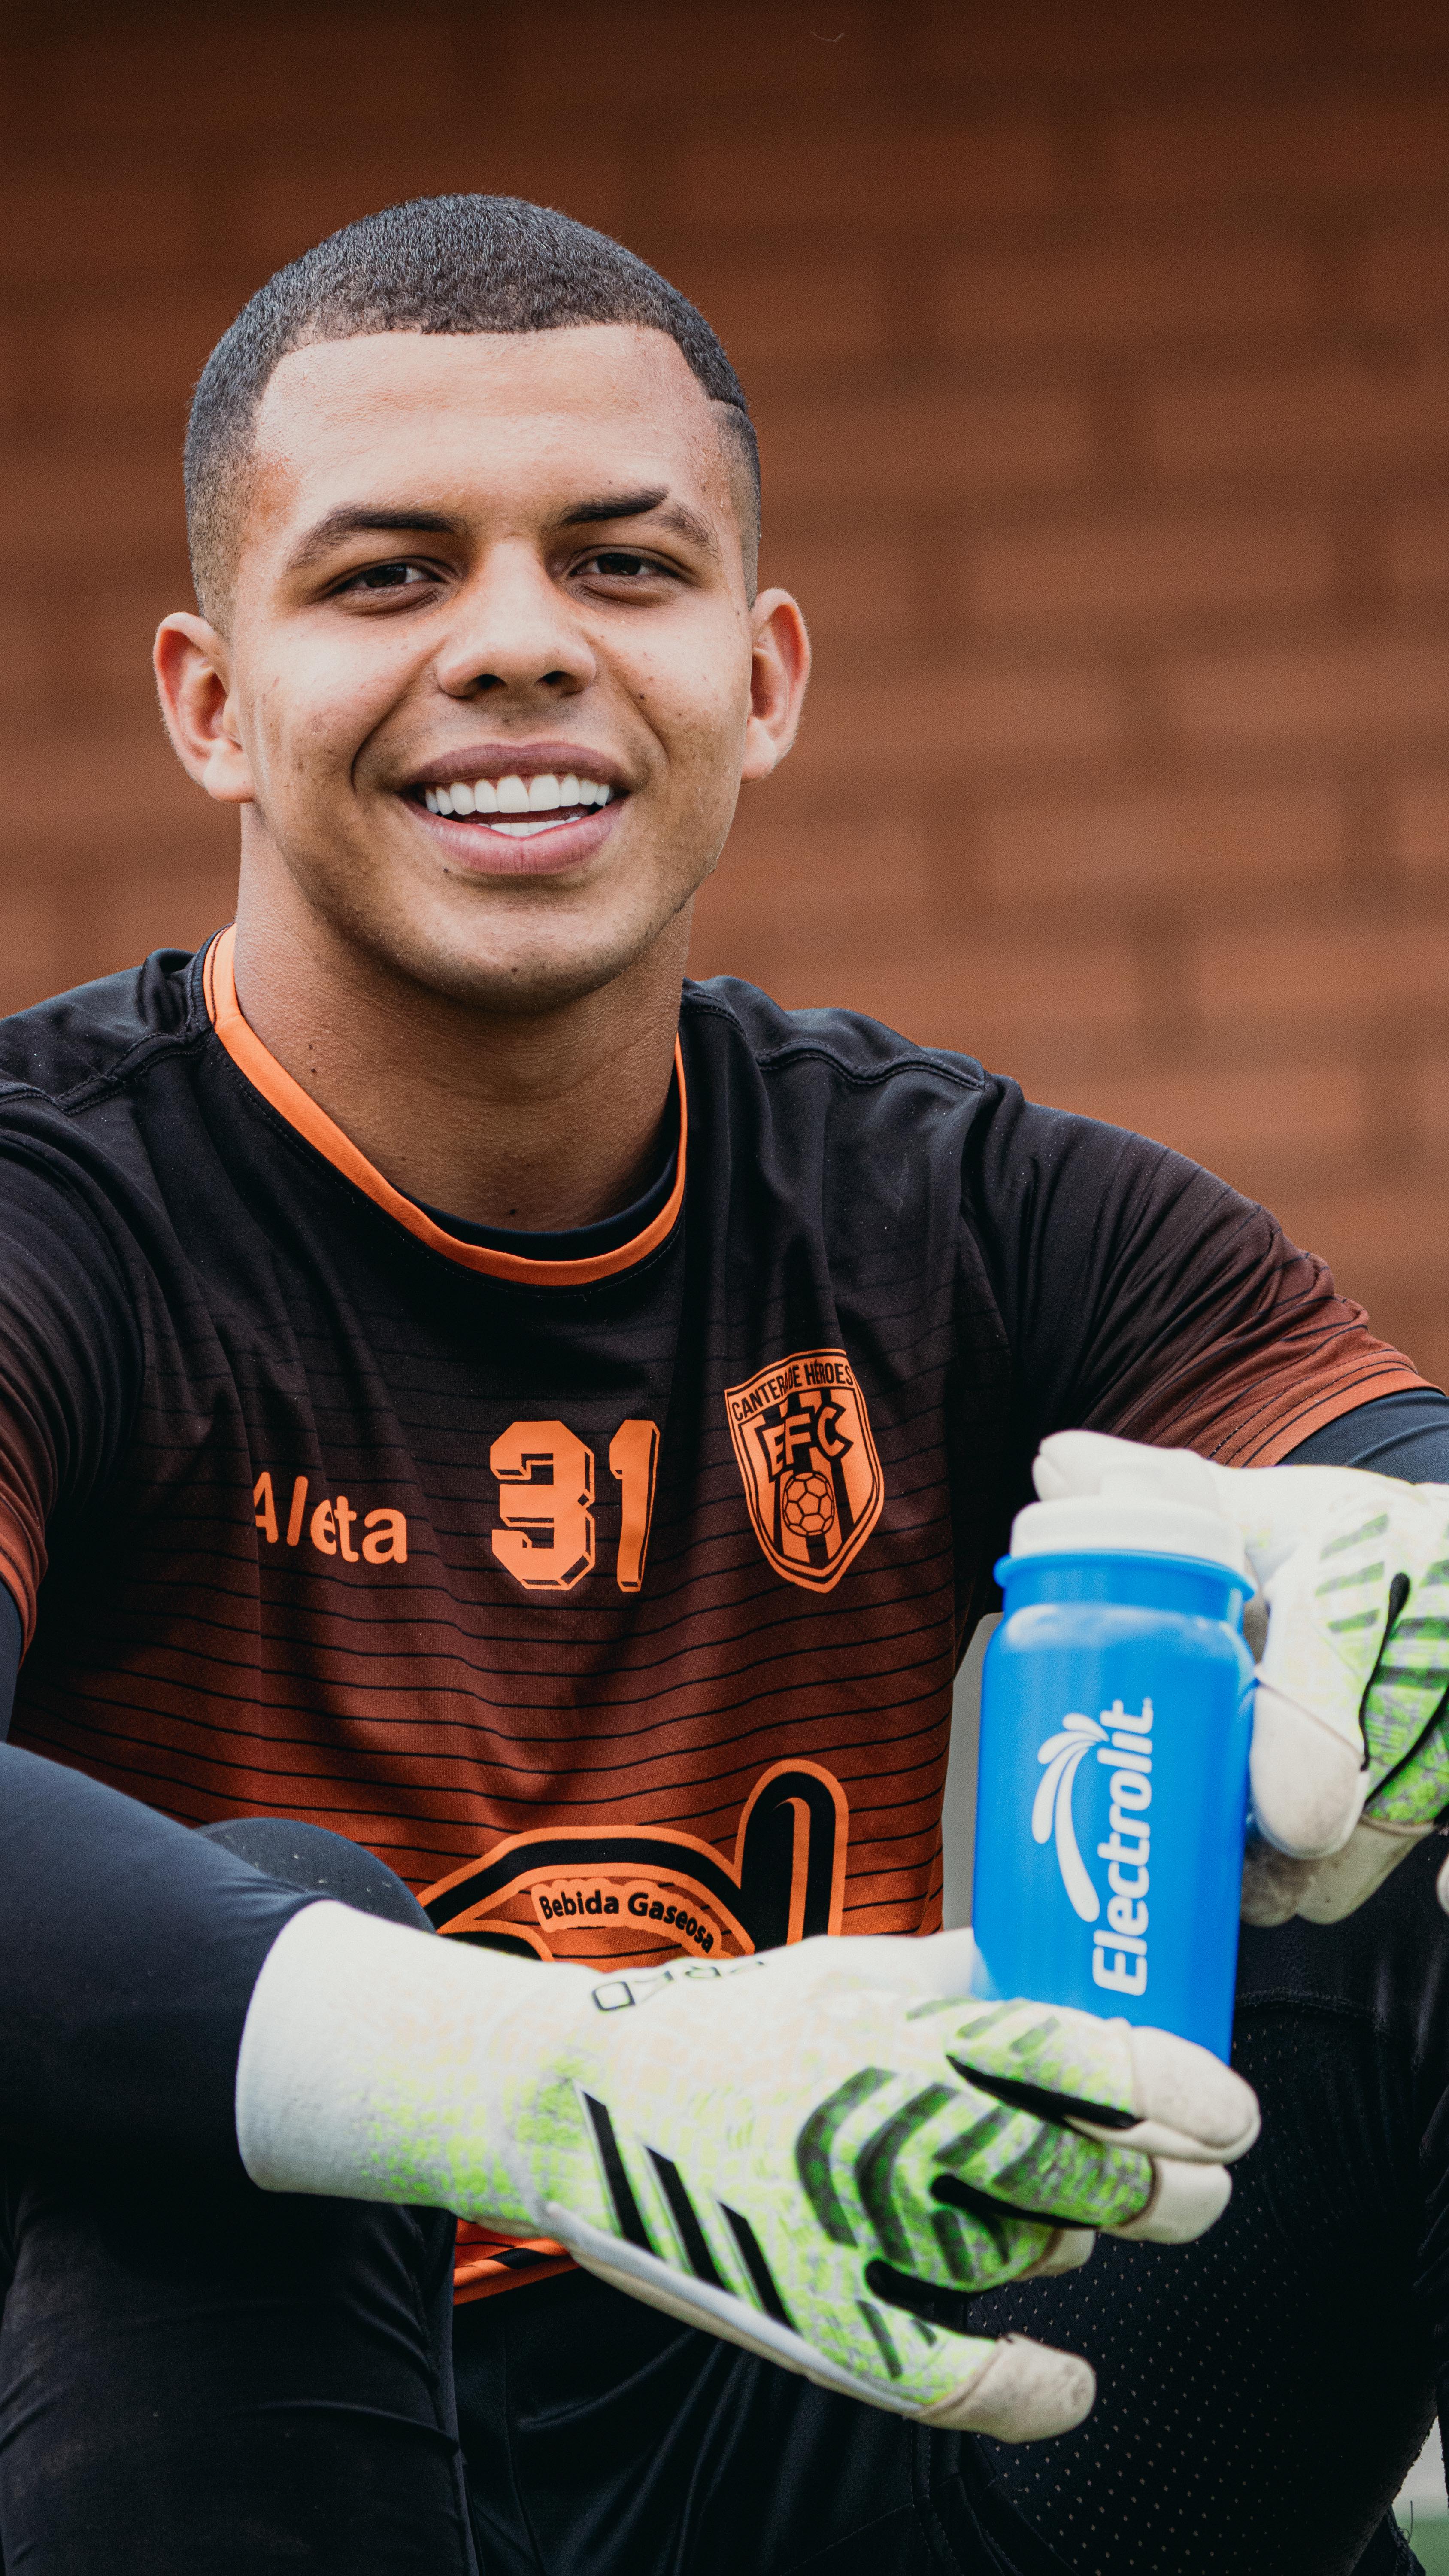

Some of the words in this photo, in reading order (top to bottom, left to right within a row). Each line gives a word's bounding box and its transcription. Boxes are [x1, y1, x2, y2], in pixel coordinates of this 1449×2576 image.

[761, 1404, 847, 1478] EFC
[489, 1419, 661, 1592] 31
[1092, 1697, 1154, 1996] Electrolit
[538, 1889, 619, 1920] Bebida
[627, 1892, 715, 1954] Gaseosa
